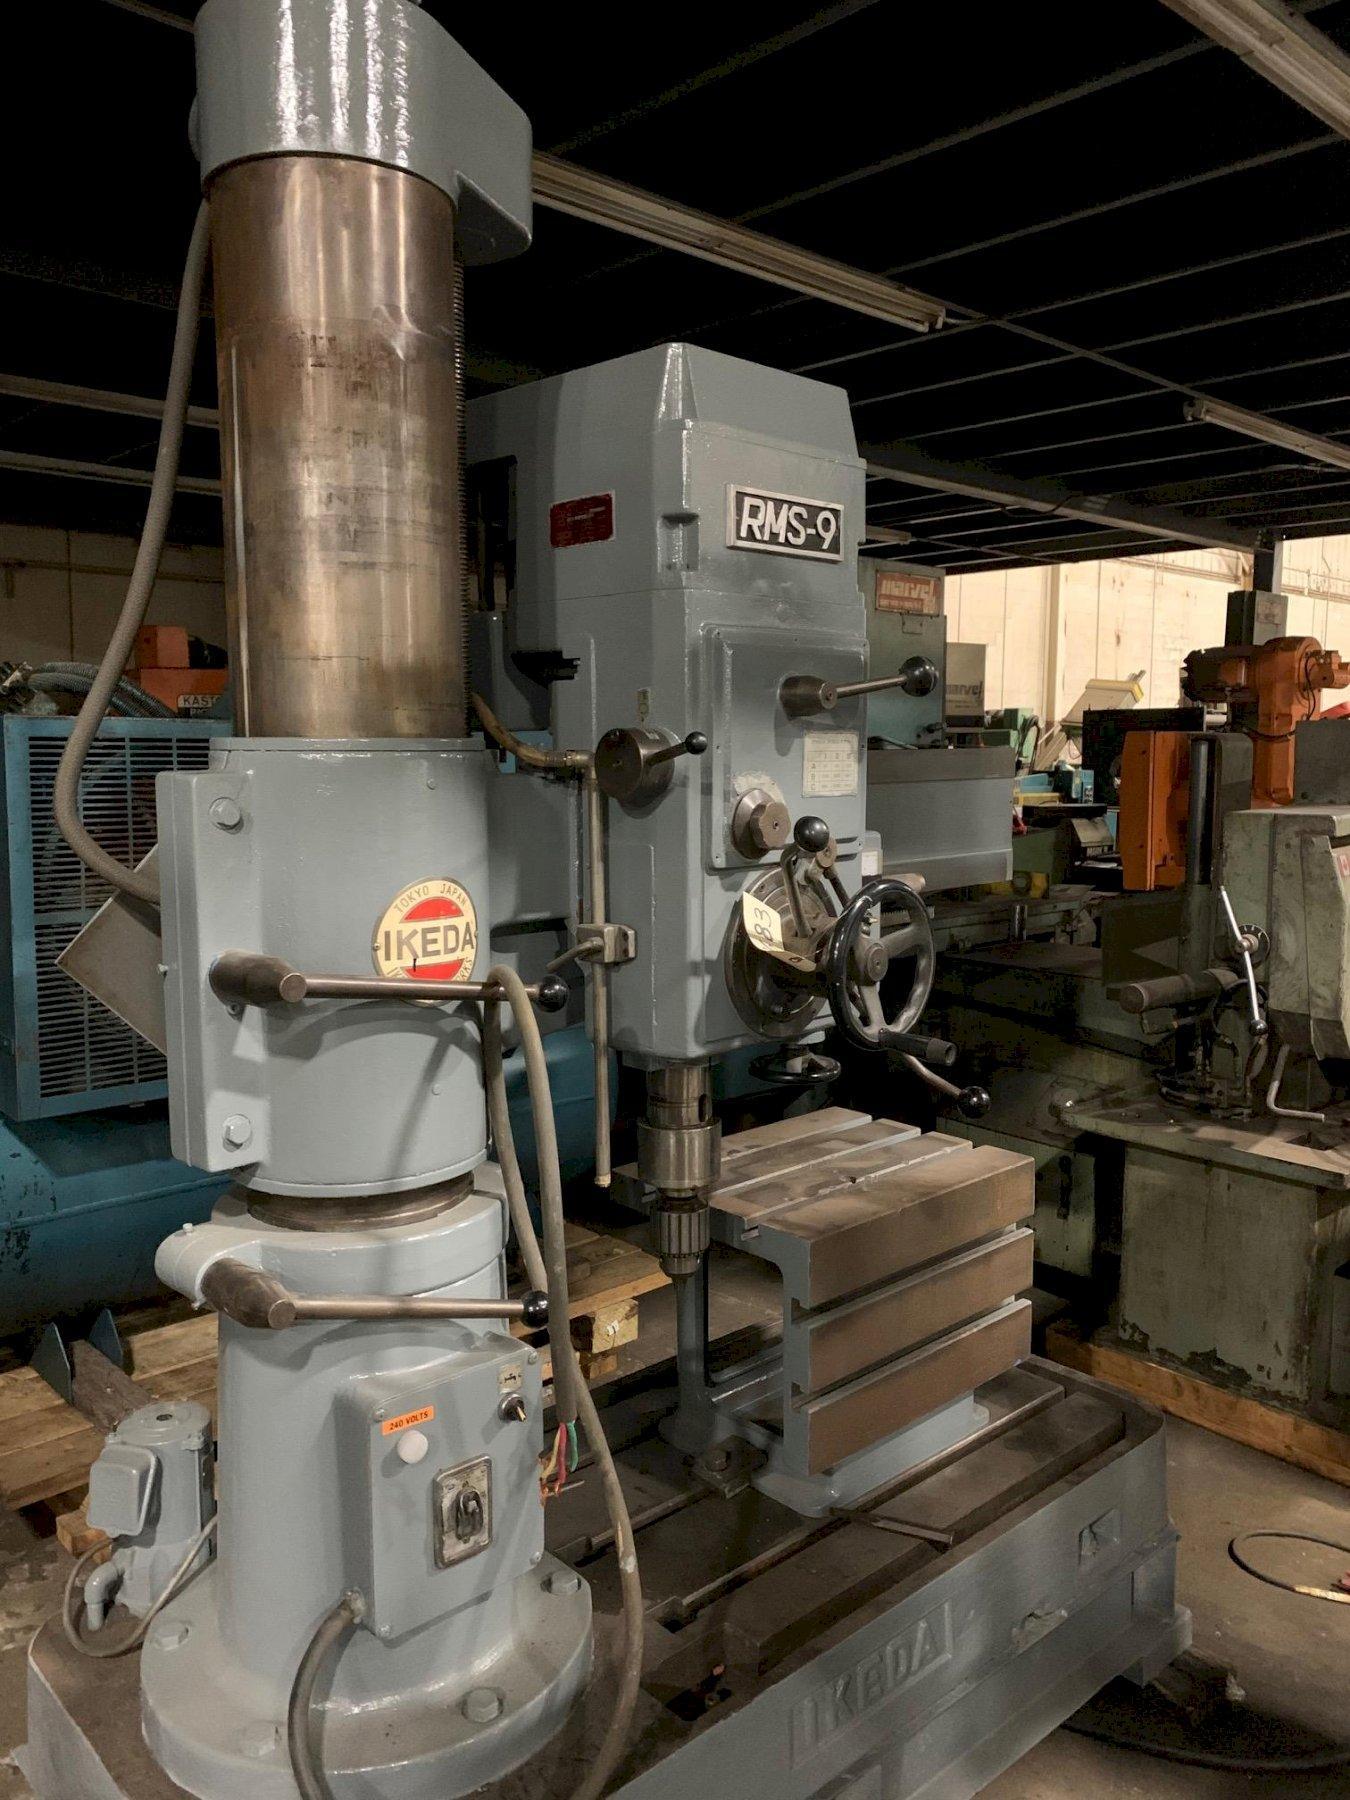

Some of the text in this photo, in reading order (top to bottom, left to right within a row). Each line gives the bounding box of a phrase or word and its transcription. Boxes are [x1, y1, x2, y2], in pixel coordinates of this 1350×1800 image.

[740, 496, 837, 550] RMS-9
[394, 883, 467, 914] TOKYO JAPAN
[384, 921, 475, 961] IKEDA
[406, 1410, 429, 1425] VOLTS
[803, 1619, 941, 1745] IKEDA
